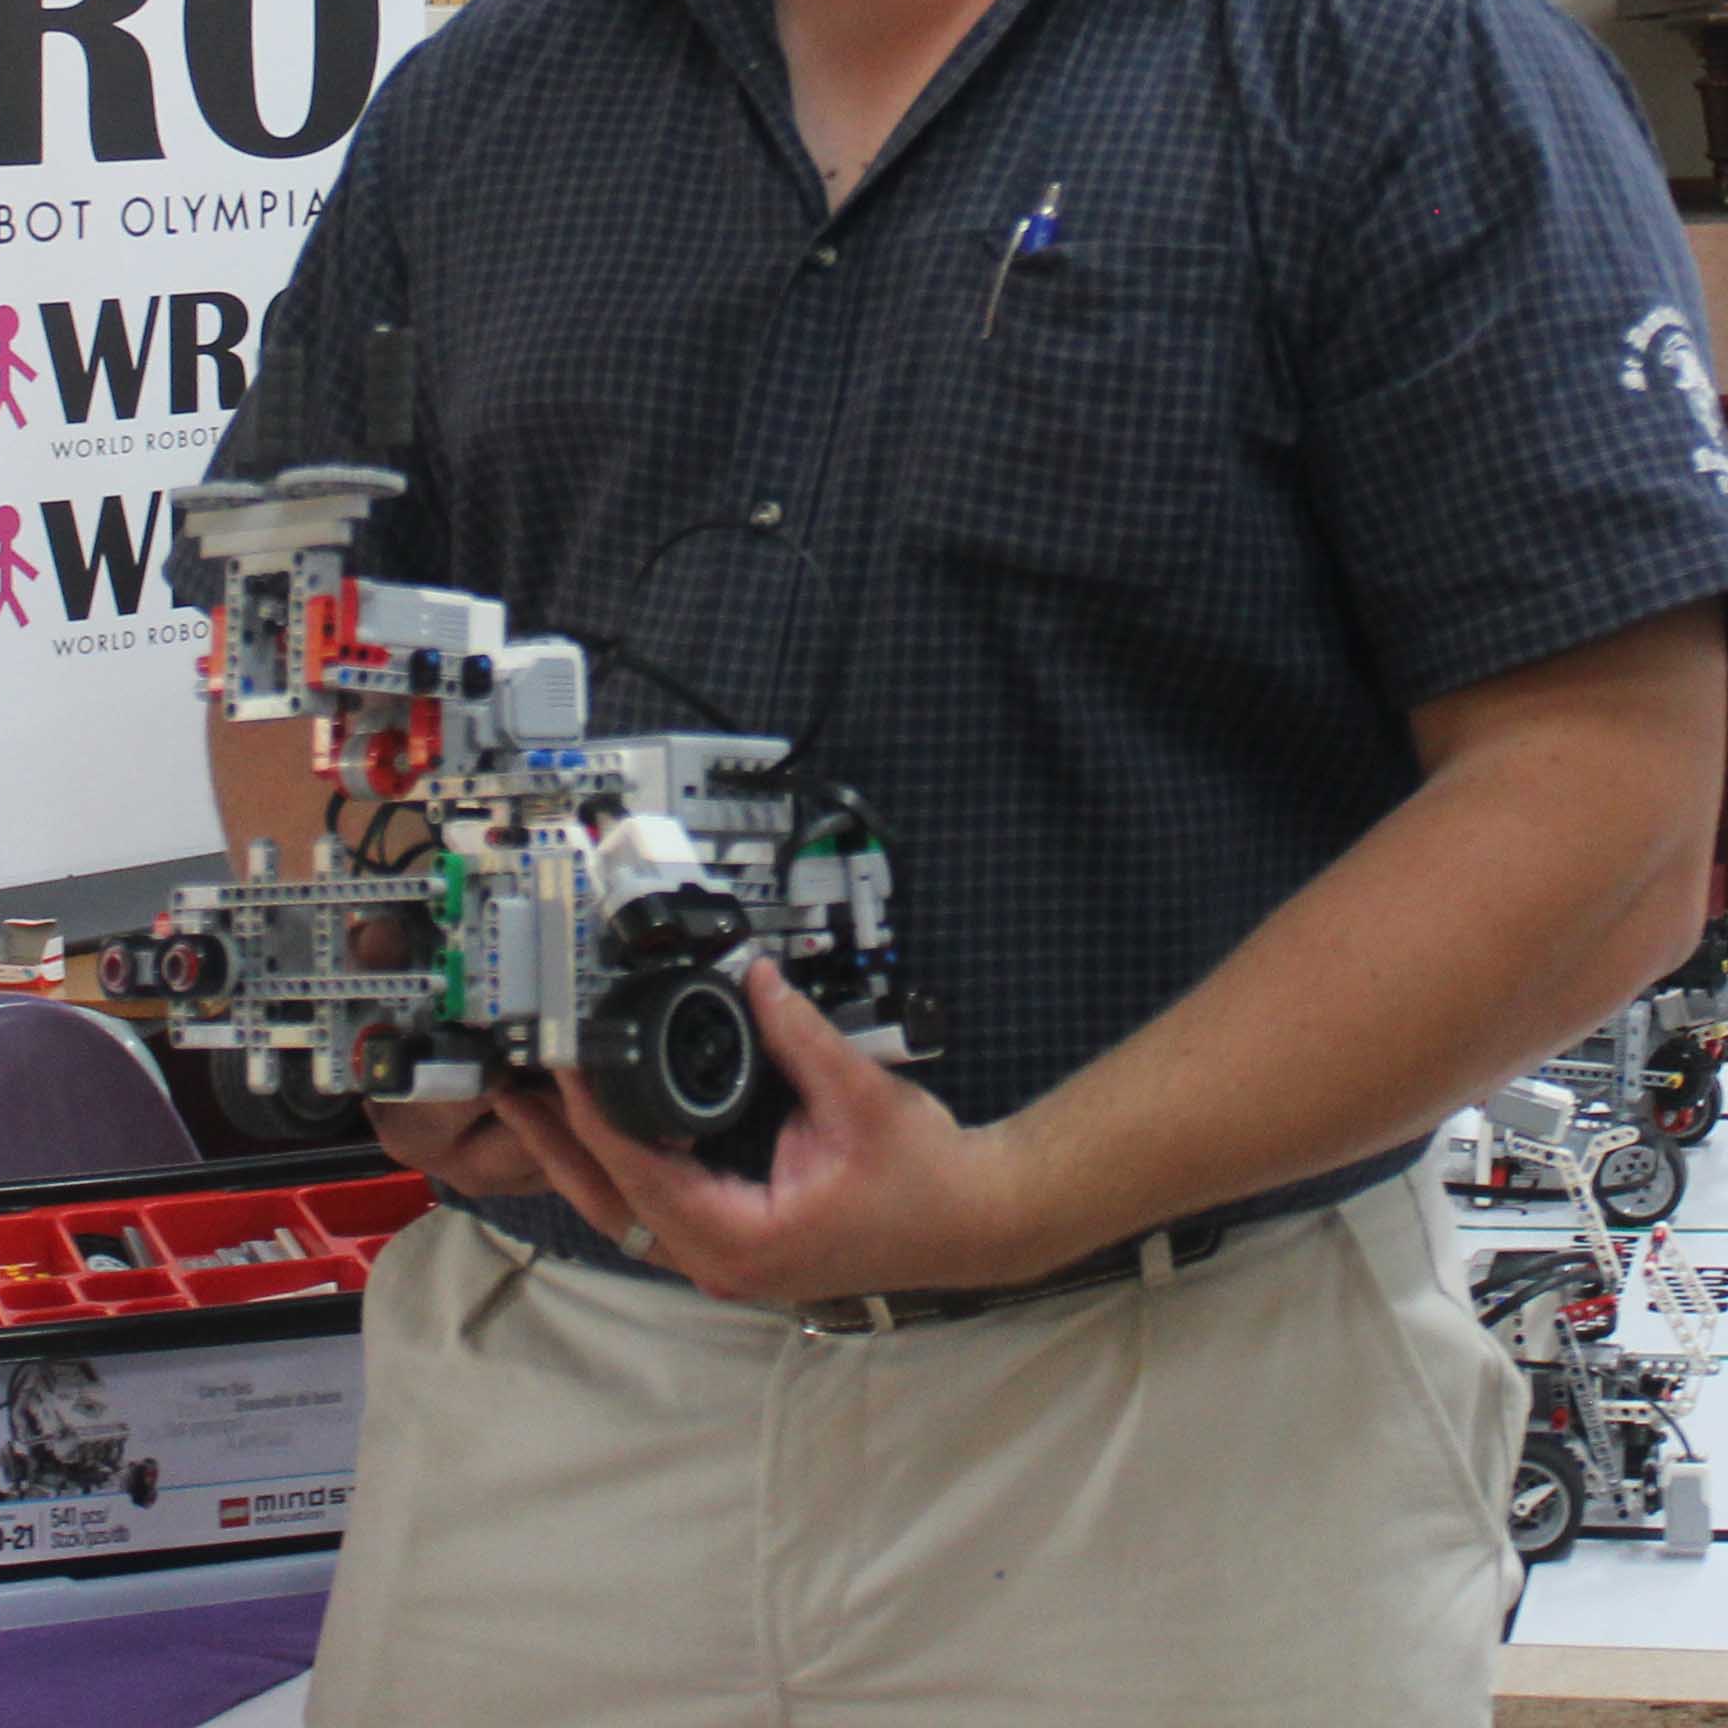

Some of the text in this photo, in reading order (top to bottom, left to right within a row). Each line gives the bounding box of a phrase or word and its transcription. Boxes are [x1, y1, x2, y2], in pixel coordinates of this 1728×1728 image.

[121, 188, 325, 237] OLYMPIA
[38, 288, 290, 425] WR
[51, 427, 221, 459] WORLD ROBOT
[53, 620, 210, 656] WORLD ROBO
